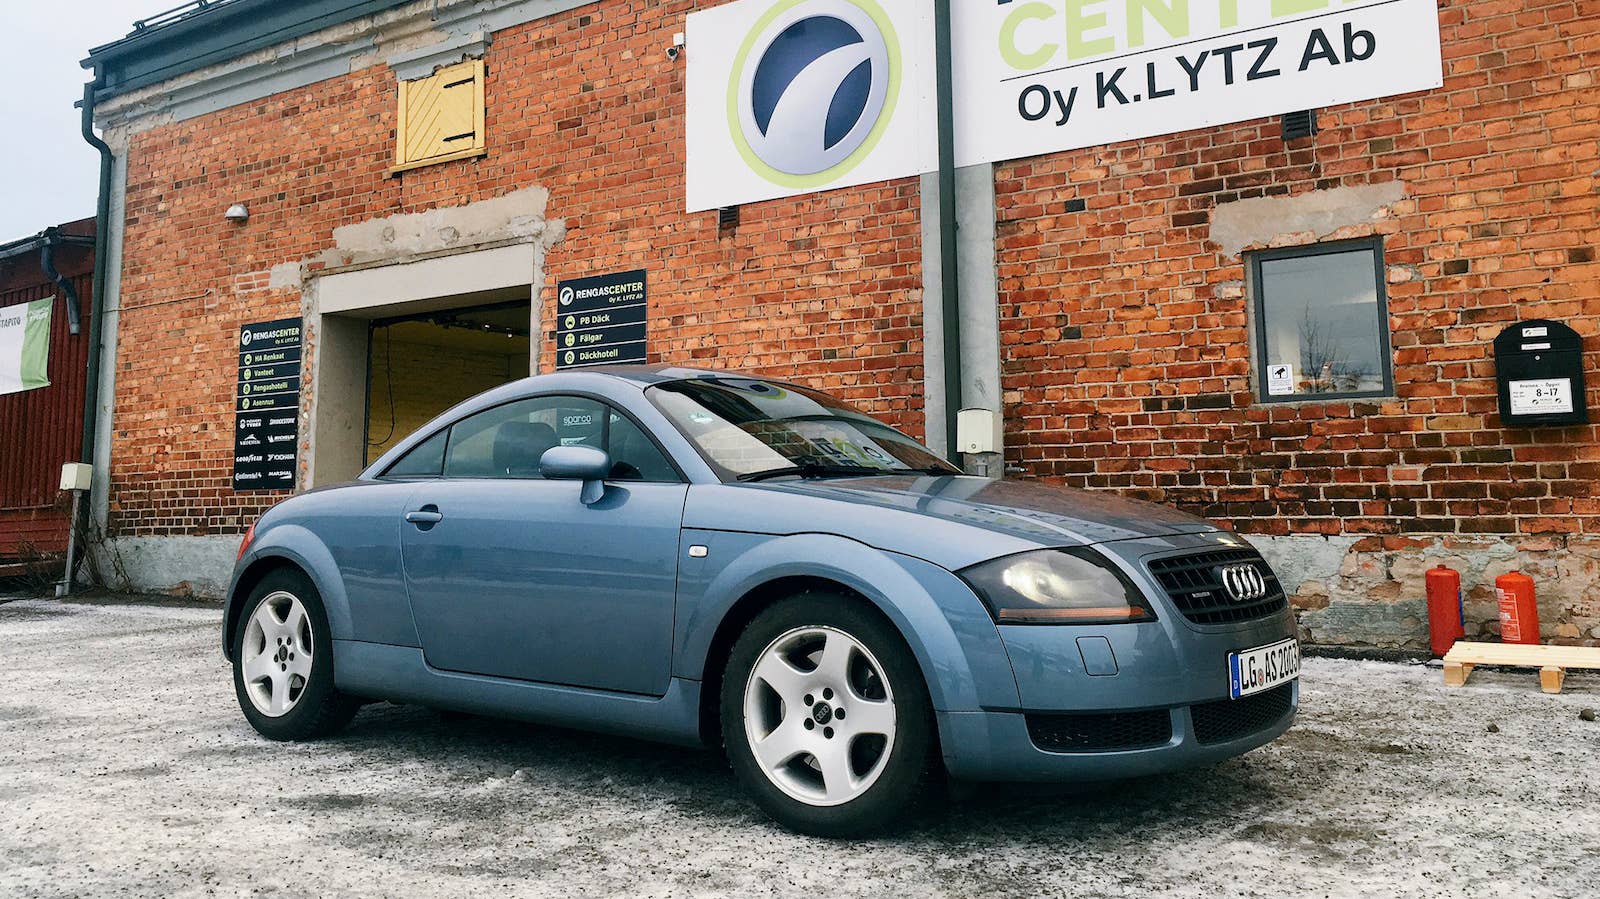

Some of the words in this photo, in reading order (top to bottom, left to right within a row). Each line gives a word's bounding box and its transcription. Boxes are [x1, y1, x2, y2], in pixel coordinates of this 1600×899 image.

[999, 0, 1366, 70] CEN
[1017, 84, 1079, 126] Oy
[1095, 37, 1281, 109] K.LYTZ
[1298, 22, 1377, 72] Ab
[576, 282, 643, 299] RENGASCENTER
[622, 293, 635, 301] LYTZ
[580, 316, 590, 325] PB
[591, 313, 610, 323] Däck
[253, 327, 300, 341] RENGASCENTER
[580, 333, 603, 343] Fälgar
[263, 352, 285, 361] Renkaat
[580, 348, 618, 360] Däckhotell
[253, 368, 274, 377] Vanteet
[252, 399, 274, 407] Asennus
[563, 415, 592, 426] sparco
[1240, 656, 1257, 690] LG
[1265, 650, 1277, 683] AS
[1278, 643, 1298, 679] 2003
